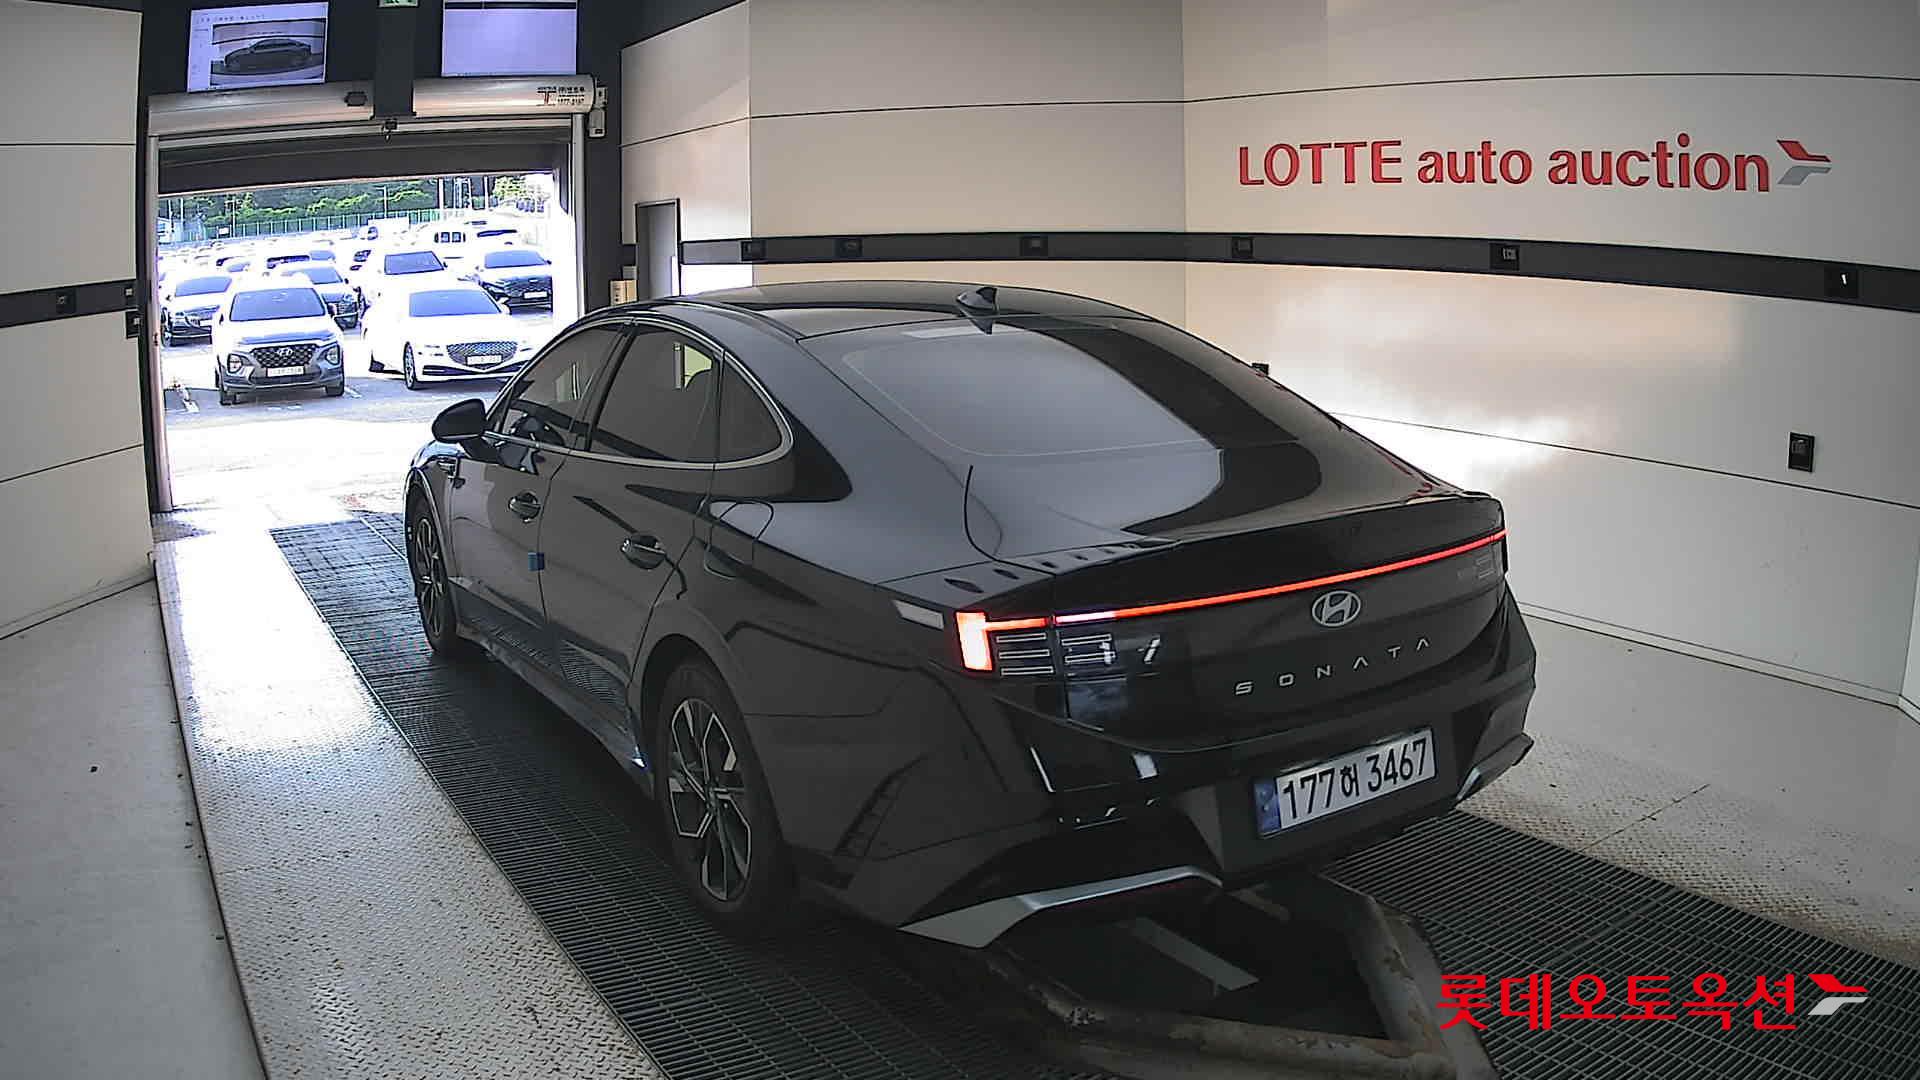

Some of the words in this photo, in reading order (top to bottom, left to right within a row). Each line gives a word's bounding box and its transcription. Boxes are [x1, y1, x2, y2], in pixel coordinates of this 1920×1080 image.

[1238, 139, 1402, 187] LOTTE
[1417, 140, 1533, 185] auto
[1547, 133, 1770, 192] auction
[1234, 637, 1430, 695] SONATA
[1283, 763, 1360, 819] 177허
[1366, 738, 1427, 792] 3467
